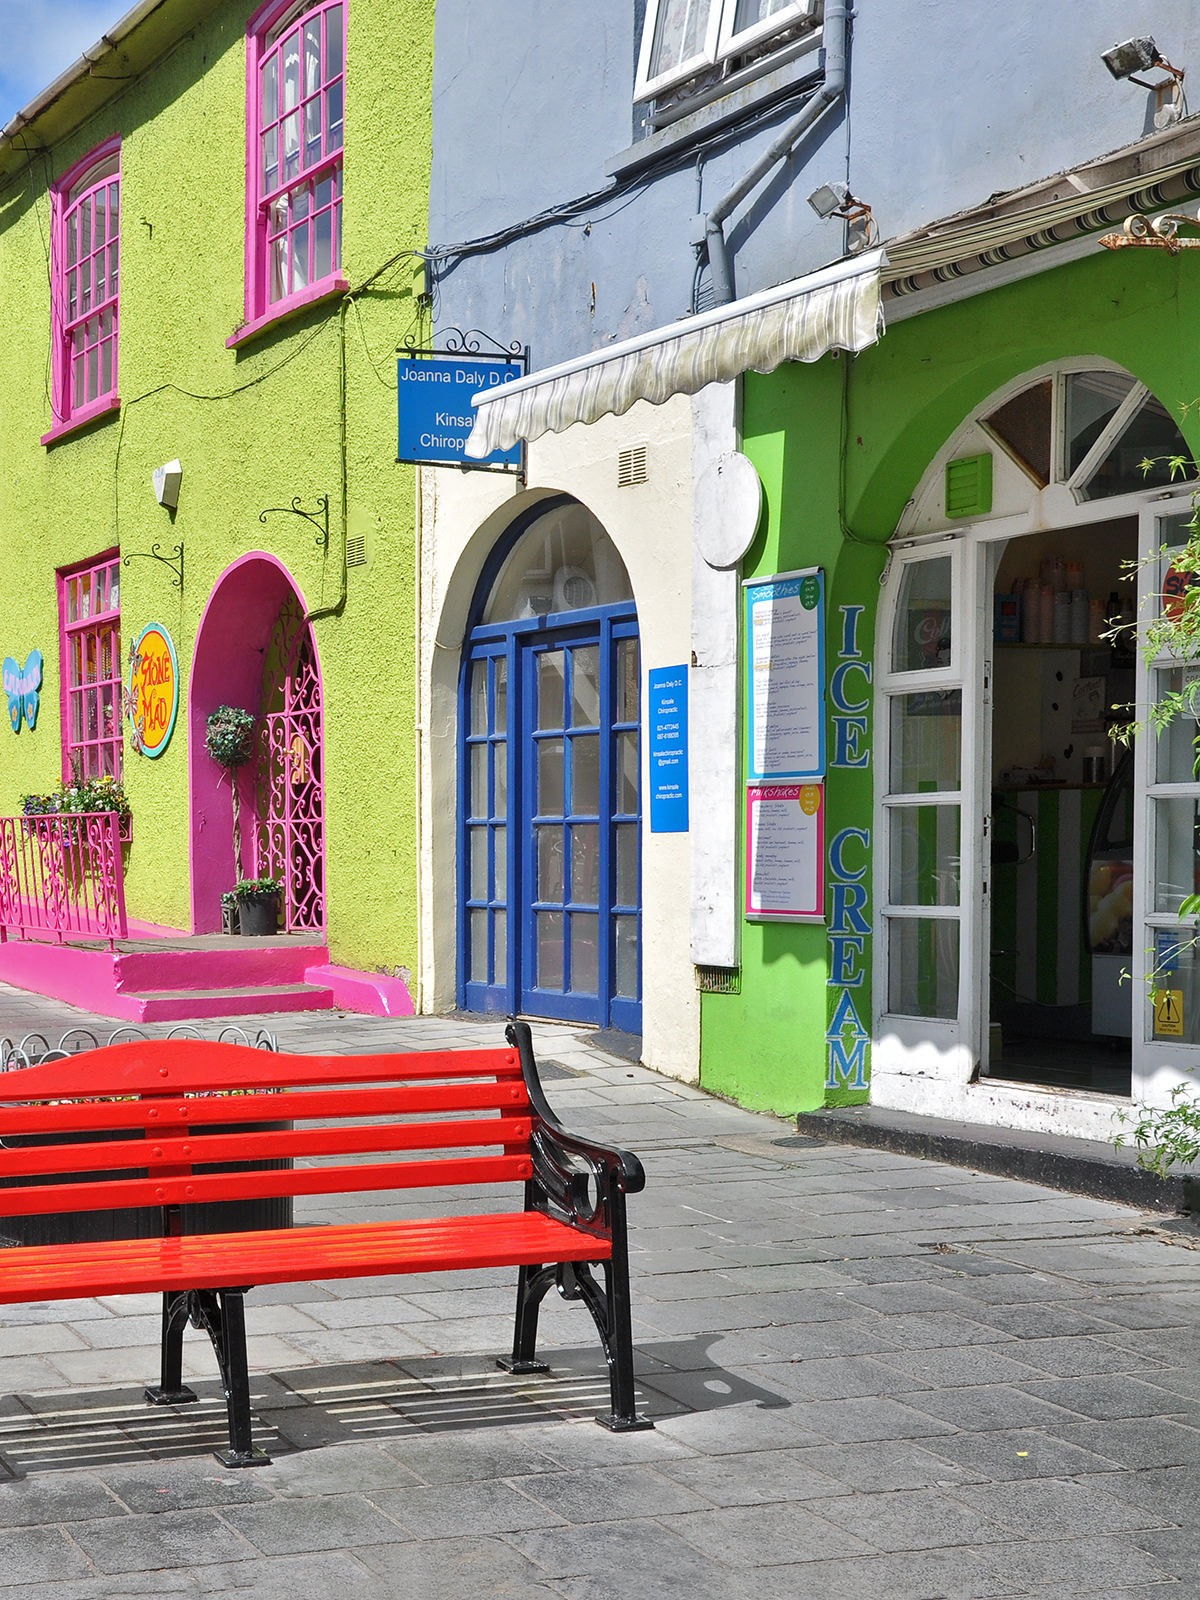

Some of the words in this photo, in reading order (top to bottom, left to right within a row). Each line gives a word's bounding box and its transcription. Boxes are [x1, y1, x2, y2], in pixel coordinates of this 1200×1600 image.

[401, 367, 451, 383] Joanna
[455, 370, 486, 388] Daly
[435, 412, 476, 428] Kinsal
[420, 433, 467, 451] Chirop
[829, 604, 873, 769] ICE
[751, 786, 799, 797] Milkshakes
[824, 826, 873, 1090] CREAM
